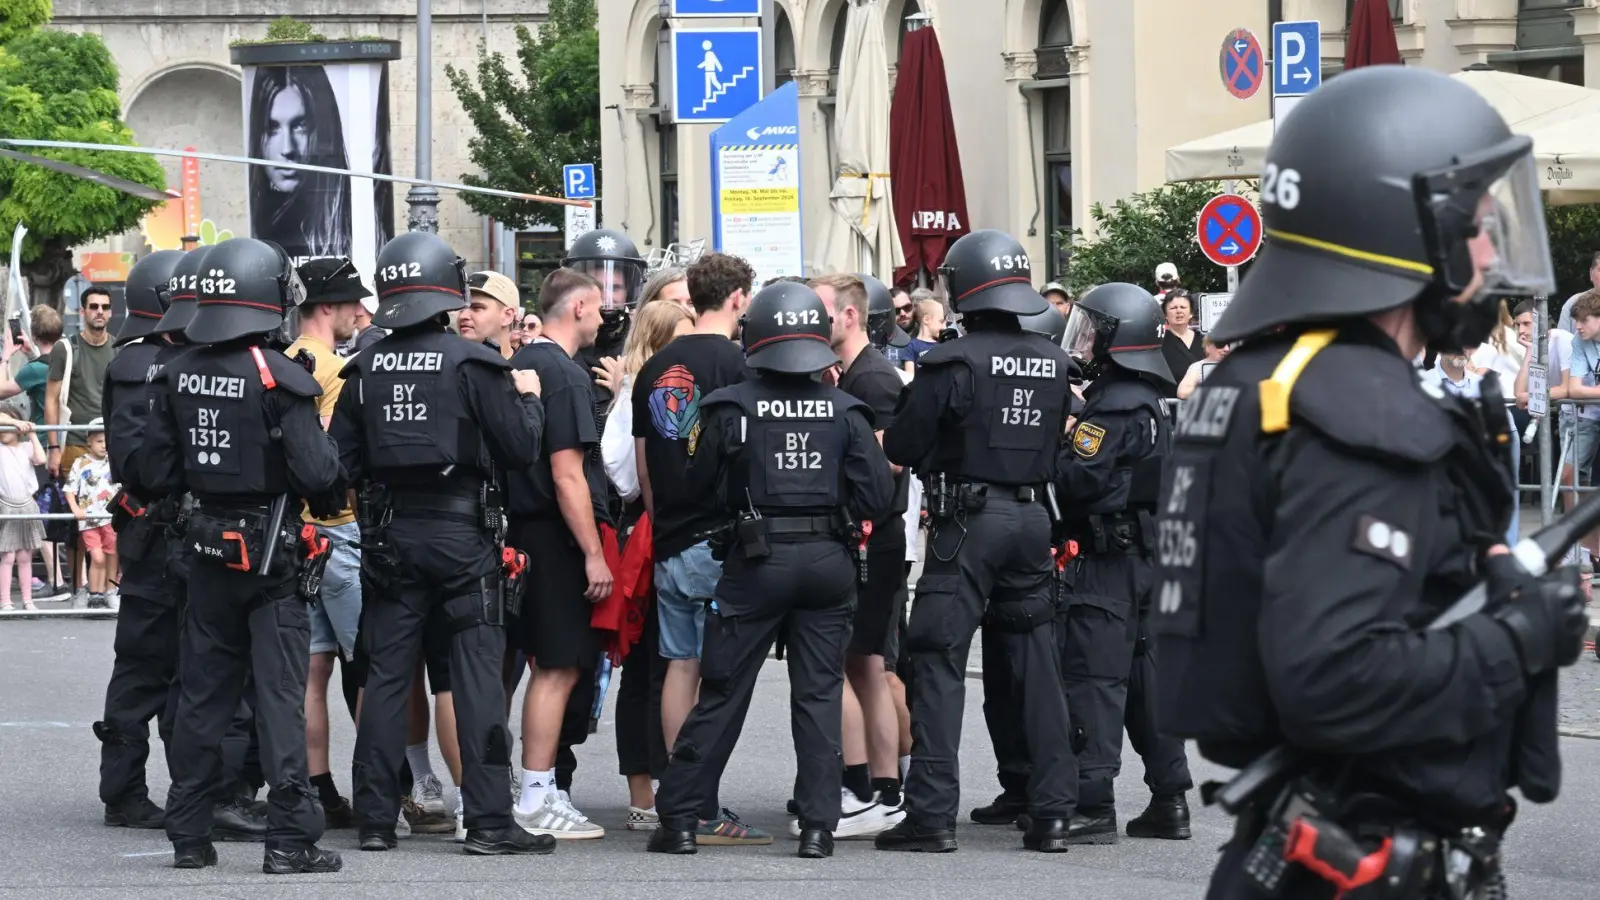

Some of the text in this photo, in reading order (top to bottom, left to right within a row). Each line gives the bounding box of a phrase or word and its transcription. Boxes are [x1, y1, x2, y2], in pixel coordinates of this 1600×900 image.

[1281, 31, 1306, 86] P
[762, 125, 797, 135] MVG
[568, 168, 586, 194] P
[1263, 162, 1301, 210] 26
[380, 262, 422, 283] 1312
[990, 255, 1029, 271] 1312
[200, 278, 236, 294] 1312
[774, 309, 820, 326] 1312
[371, 352, 443, 372] POLIZEI
[991, 356, 1056, 378] POLIZEI
[177, 373, 246, 398] POLIZEI
[393, 383, 416, 402] BY
[1013, 388, 1034, 407] BY
[198, 408, 220, 428] BY
[383, 403, 427, 422] 1312
[757, 400, 834, 418] POLIZEI
[1001, 407, 1042, 427] 1312
[189, 428, 231, 448] 1312
[1080, 424, 1104, 438] POLIZEI
[785, 432, 810, 451] BY
[774, 452, 822, 470] 1312
[204, 546, 224, 558] IFAK
